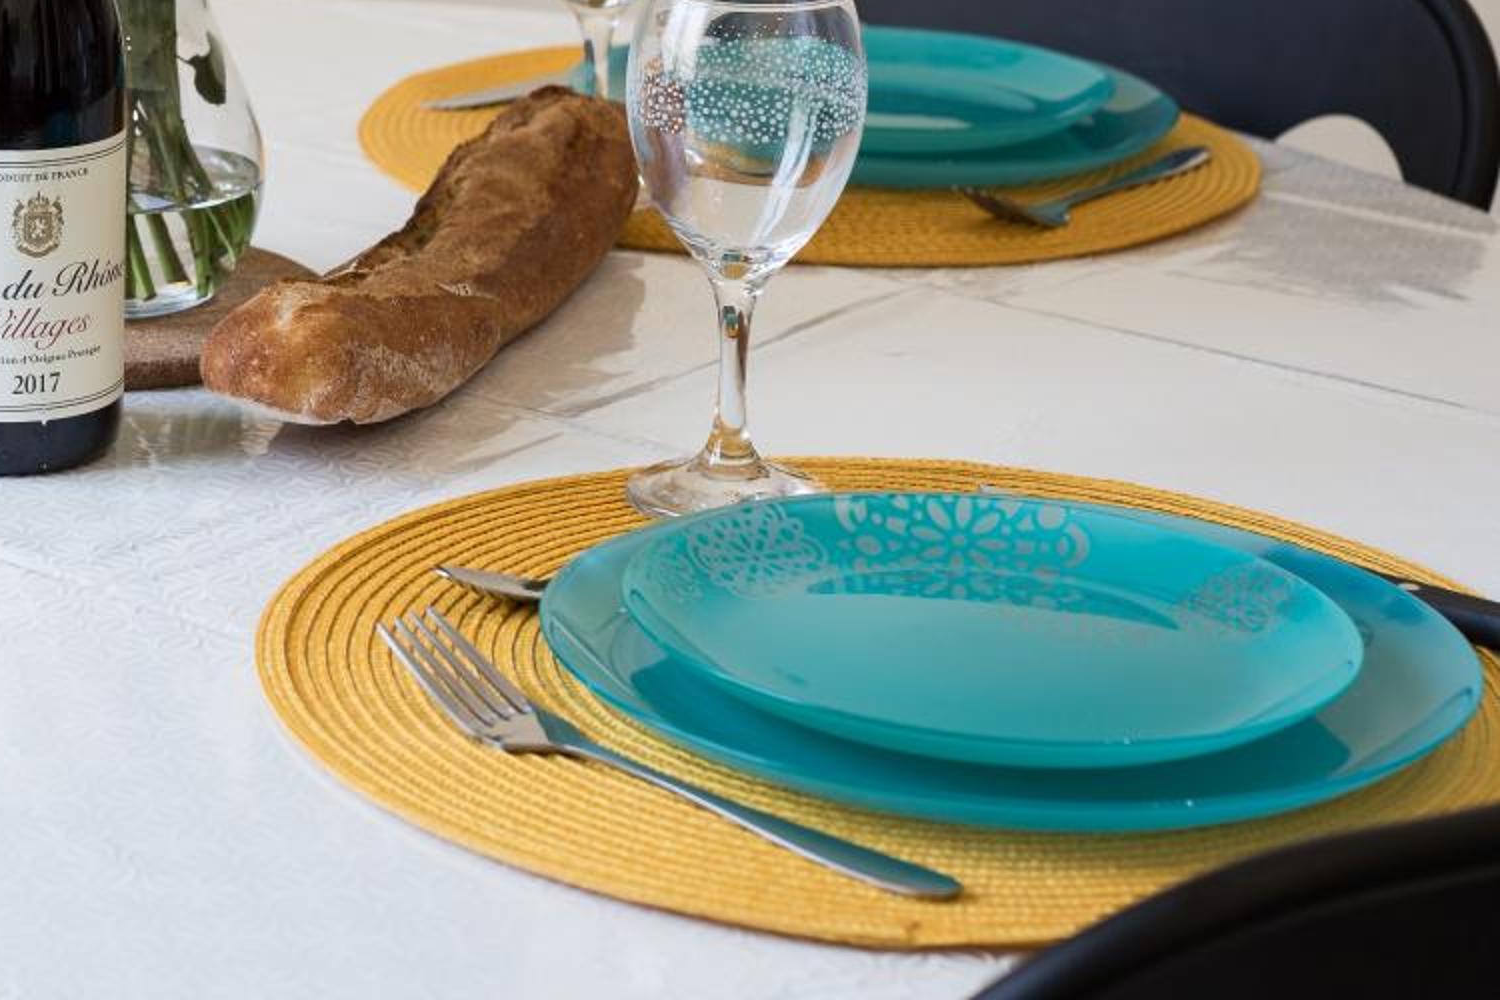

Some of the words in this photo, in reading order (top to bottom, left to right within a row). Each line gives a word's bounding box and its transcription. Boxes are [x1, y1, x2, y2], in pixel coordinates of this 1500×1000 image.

[35, 172, 49, 182] DE
[51, 167, 89, 181] FRANCE
[2, 269, 42, 301] du
[11, 371, 62, 395] 2017
